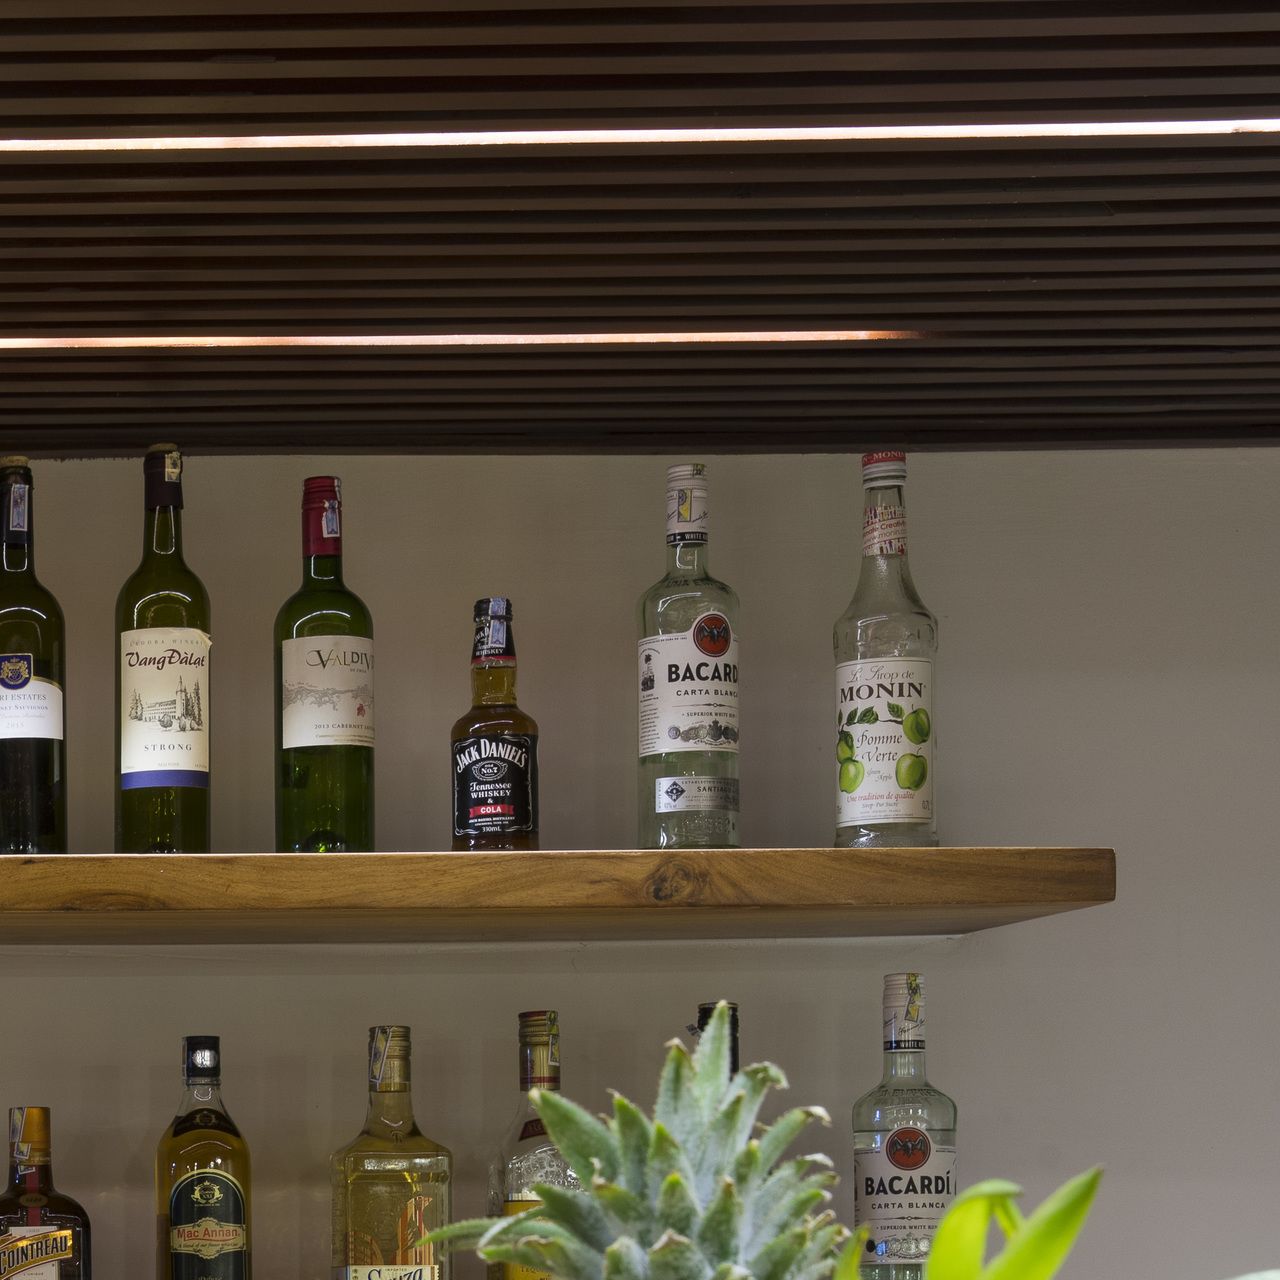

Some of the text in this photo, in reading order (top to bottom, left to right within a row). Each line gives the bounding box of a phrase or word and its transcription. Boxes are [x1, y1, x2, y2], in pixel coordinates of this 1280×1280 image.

[864, 665, 899, 684] Sirop
[901, 669, 915, 678] de
[9, 693, 47, 702] ESTATES
[676, 688, 711, 697] CARTA
[840, 682, 924, 703] MONIN
[856, 729, 903, 749] Pomme
[143, 743, 193, 752] STRONG
[456, 738, 528, 773] JACK DANIEL'S
[860, 746, 898, 762] Verte
[469, 781, 512, 792] Tennessee
[470, 790, 512, 799] WHISKEY
[857, 793, 885, 801] tradition
[885, 792, 893, 800] de
[480, 807, 502, 815] COLA
[864, 1170, 951, 1197] BACARDÍ
[871, 1202, 903, 1210] CARTA
[177, 1228, 200, 1240] Mac
